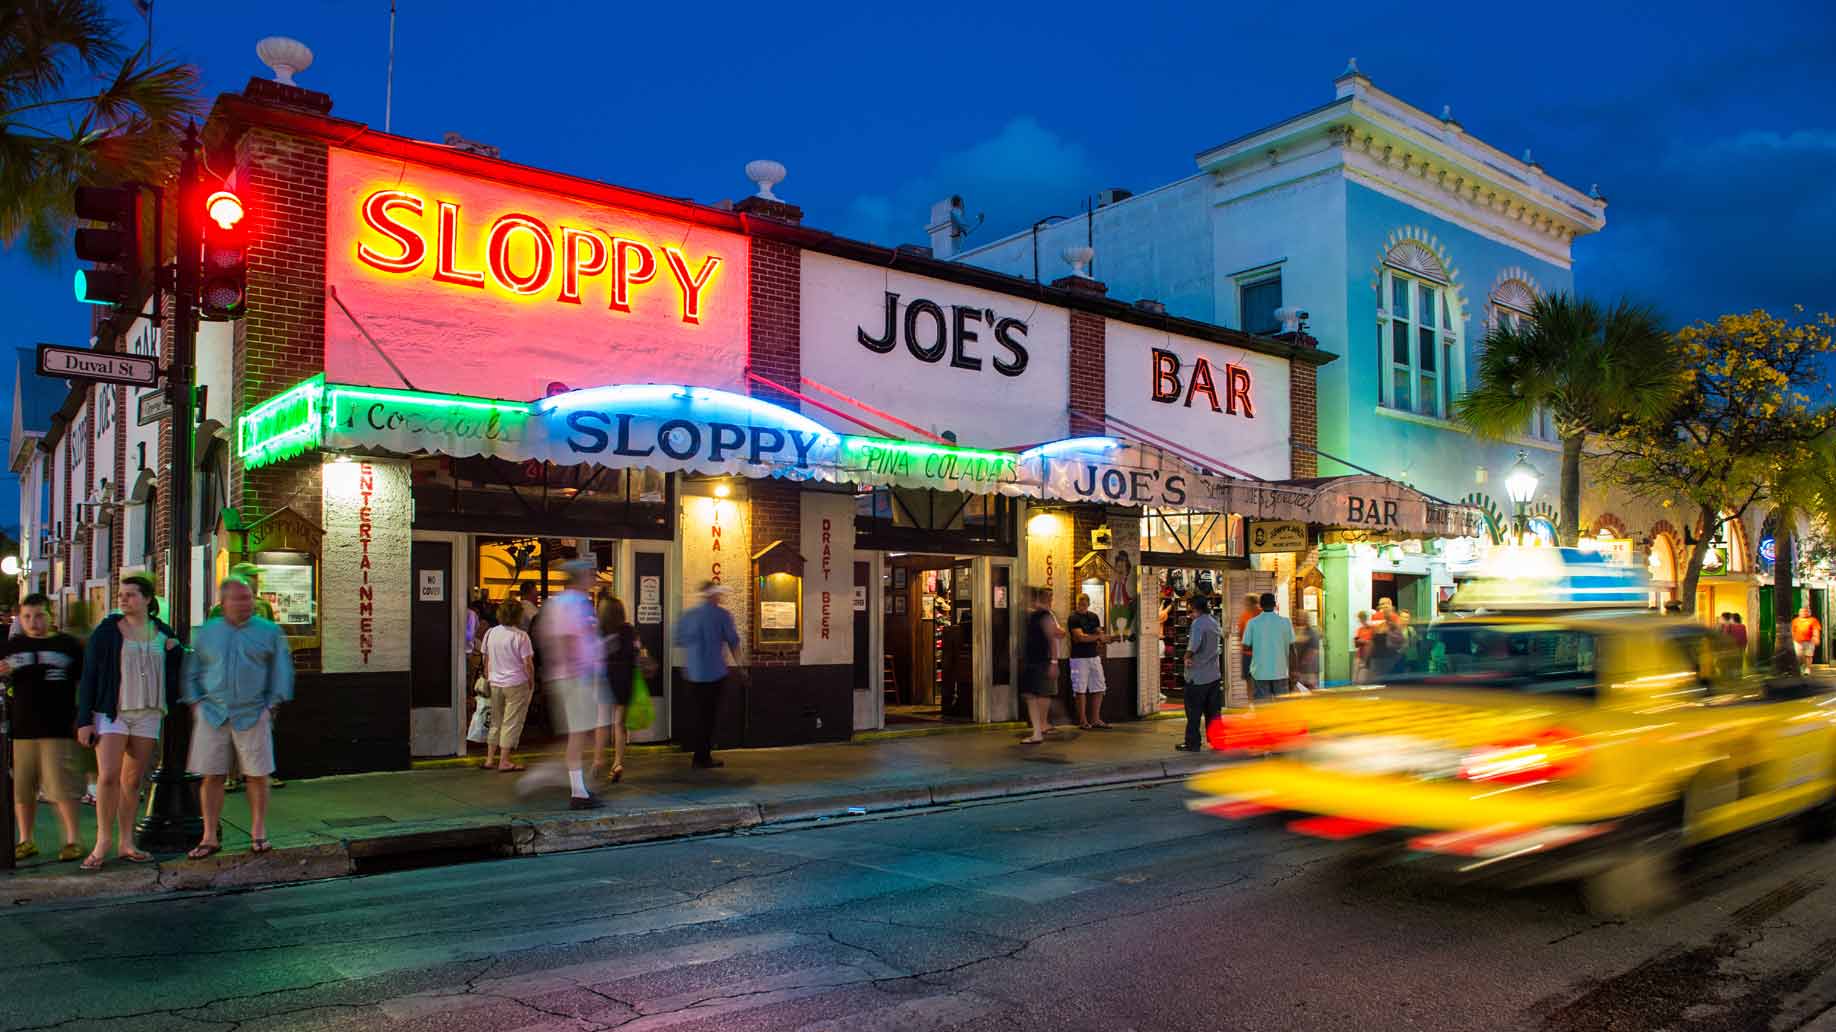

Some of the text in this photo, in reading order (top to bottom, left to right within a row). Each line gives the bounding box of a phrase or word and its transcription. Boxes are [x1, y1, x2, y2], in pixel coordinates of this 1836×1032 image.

[357, 189, 723, 326] SLOPPY
[857, 290, 1029, 378] JOE'S
[64, 354, 134, 378] Duval St
[1150, 347, 1255, 419] BAR
[565, 409, 820, 470] SLOPPY
[862, 445, 1018, 483] PINA COLADAS
[1073, 465, 1188, 506] JOE'S
[1346, 495, 1401, 527] BAR
[359, 460, 374, 665] ENTERTAINMENT
[821, 518, 832, 582] DRAFT
[427, 575, 438, 585] NO
[821, 591, 832, 641] BEER
